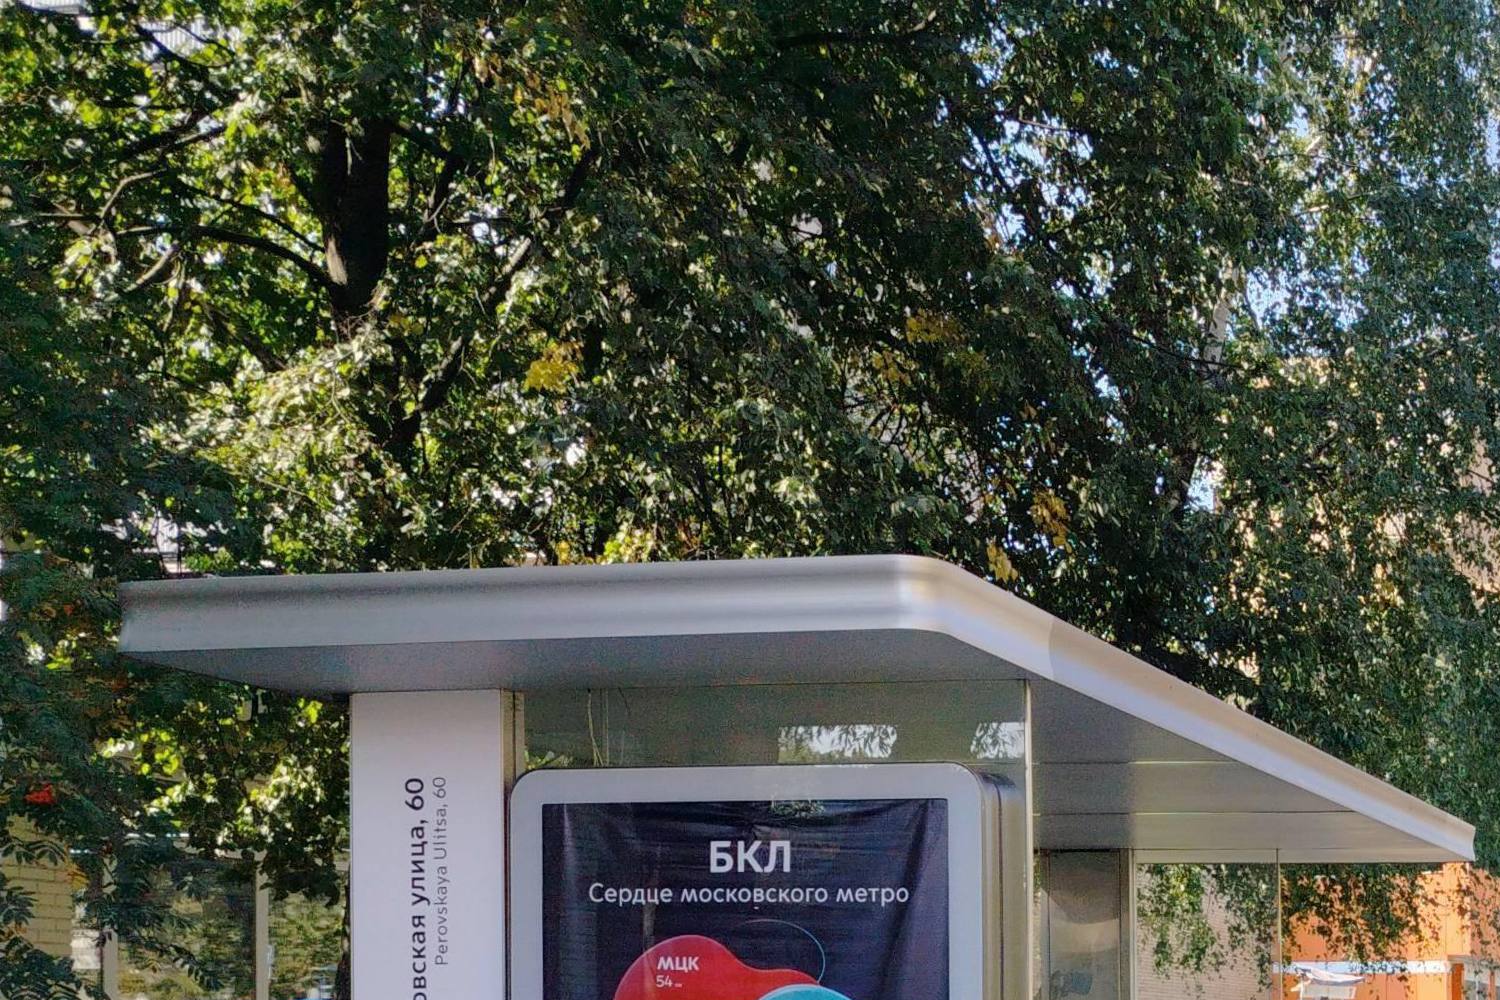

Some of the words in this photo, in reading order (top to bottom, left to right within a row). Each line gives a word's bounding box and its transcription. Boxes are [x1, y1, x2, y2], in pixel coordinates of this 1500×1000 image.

[405, 777, 425, 811] 60
[432, 776, 447, 799] 60
[433, 804, 448, 860] Ulitsa,
[409, 819, 431, 907] улица,
[709, 839, 791, 873] БКЛ
[588, 882, 673, 906] Сердце
[680, 887, 829, 903] московского
[835, 886, 909, 908] метро
[433, 866, 449, 966] Perovskaya
[656, 956, 700, 973] МЦК
[656, 974, 674, 988] 54
